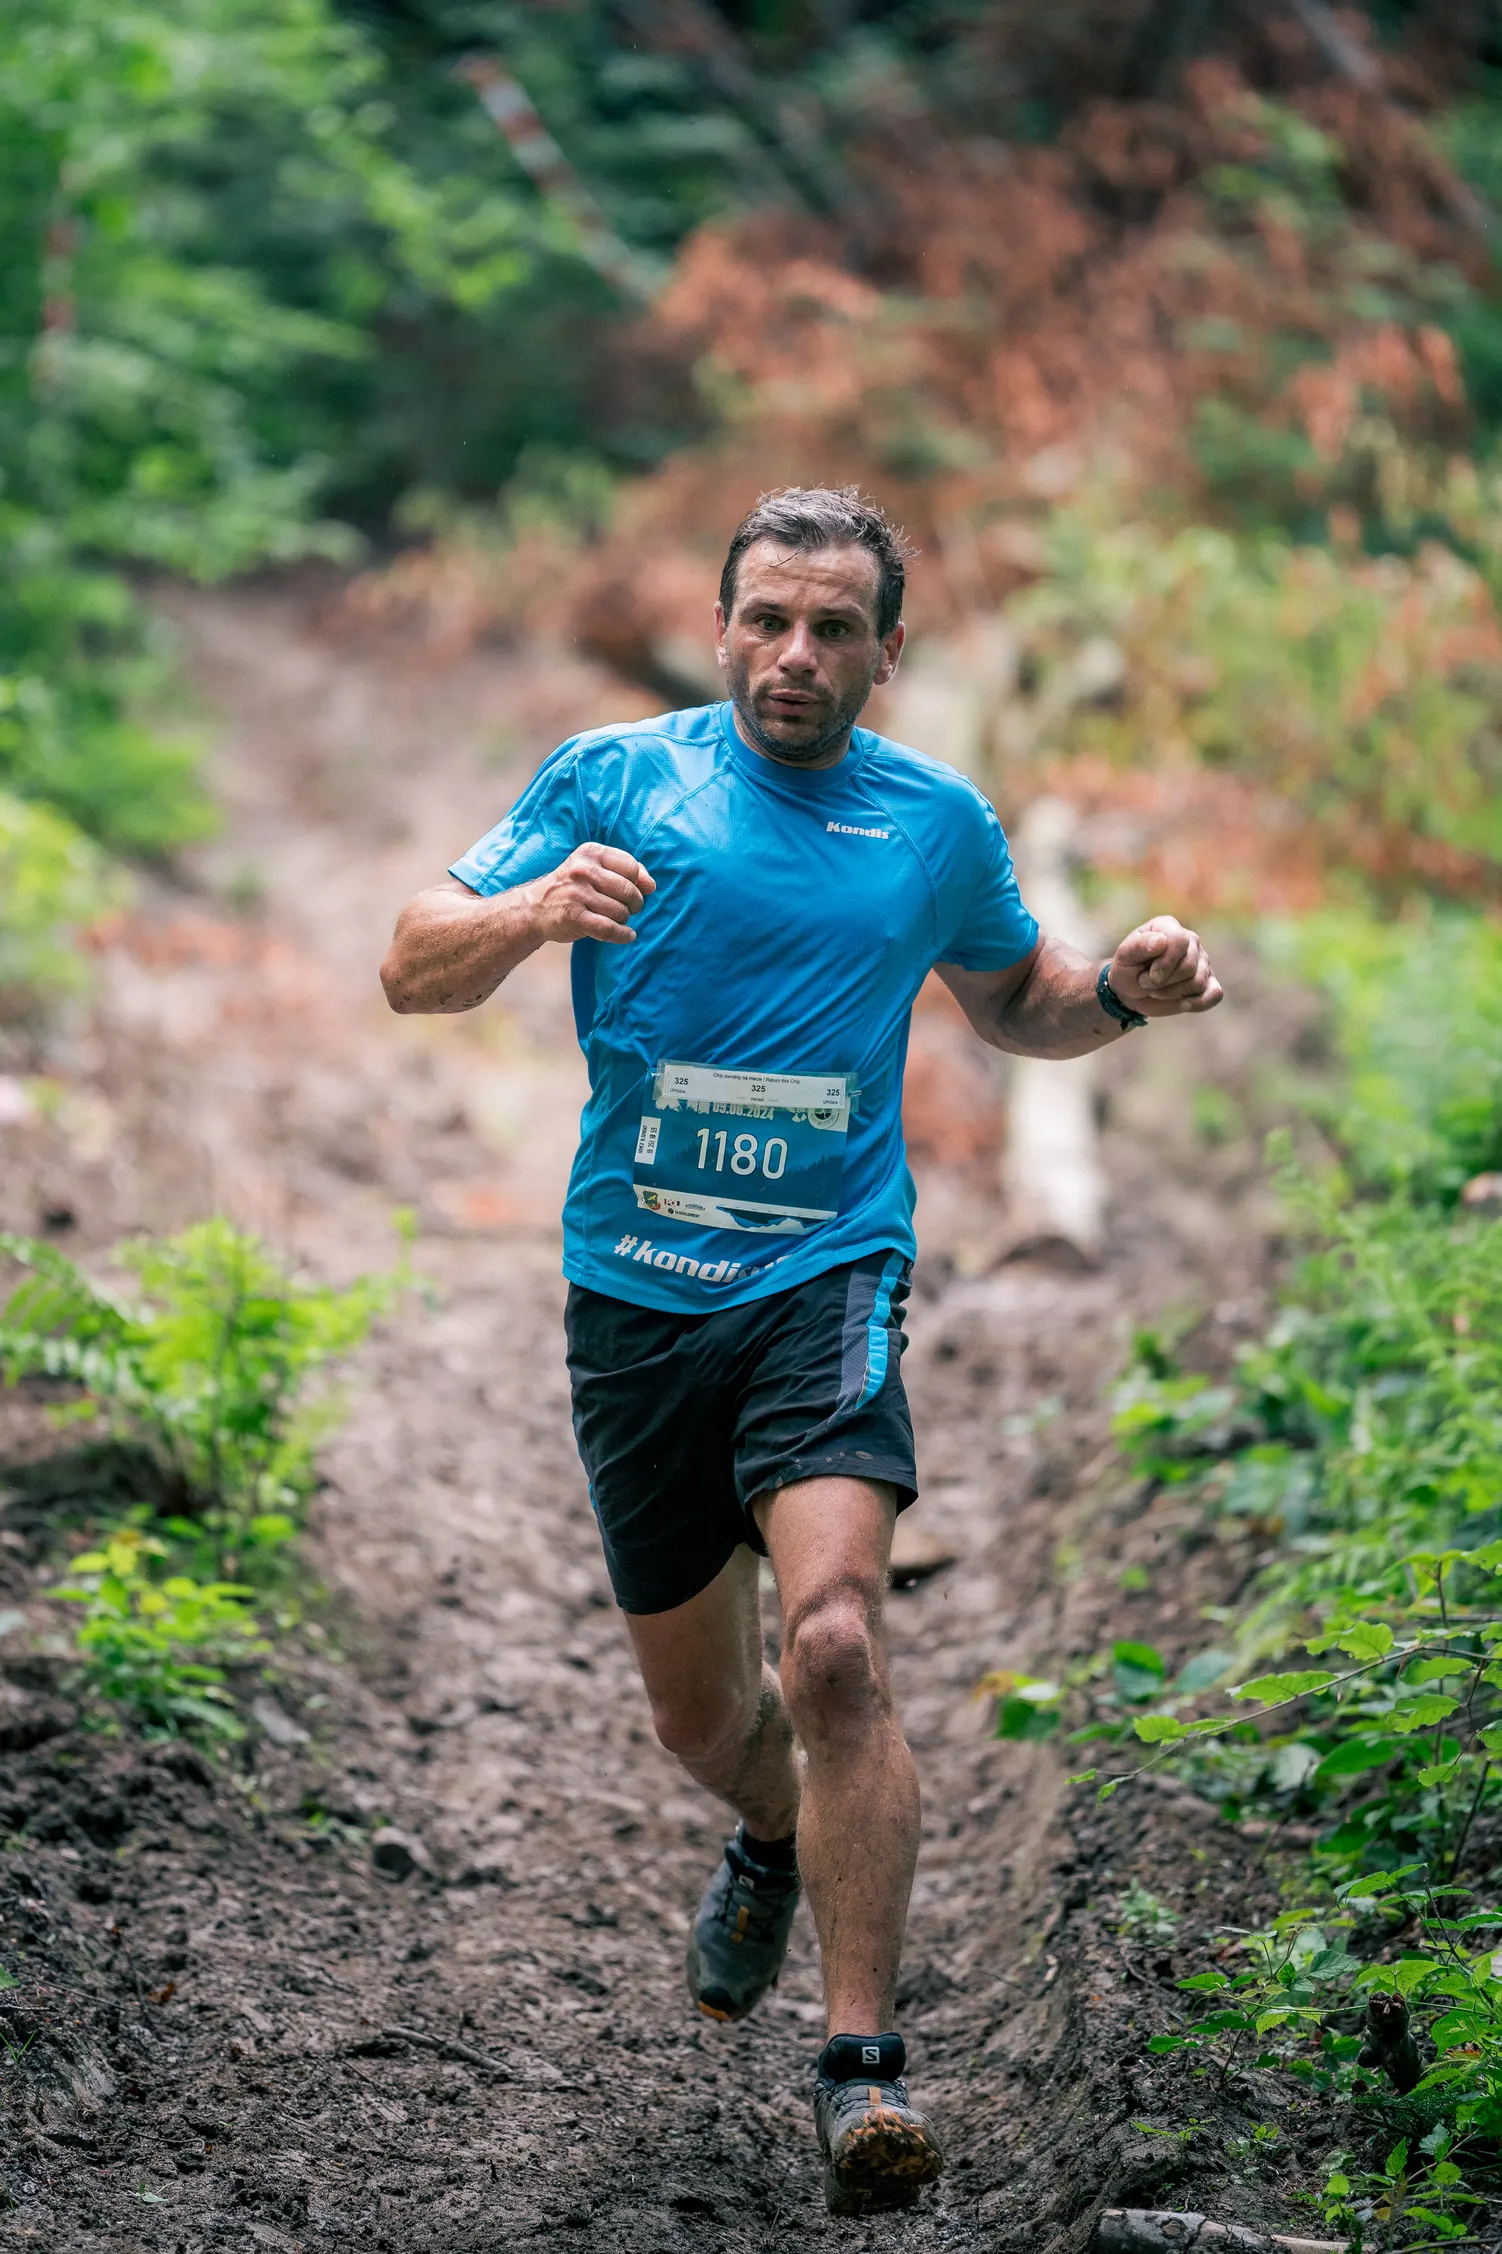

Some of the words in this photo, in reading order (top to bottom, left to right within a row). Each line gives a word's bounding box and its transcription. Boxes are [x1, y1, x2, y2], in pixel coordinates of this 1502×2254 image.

[826, 821, 890, 840] Kondis
[674, 1077, 689, 1086] 325
[751, 1084, 766, 1093] 325
[826, 1089, 841, 1097] 325
[696, 1127, 788, 1180] 1180
